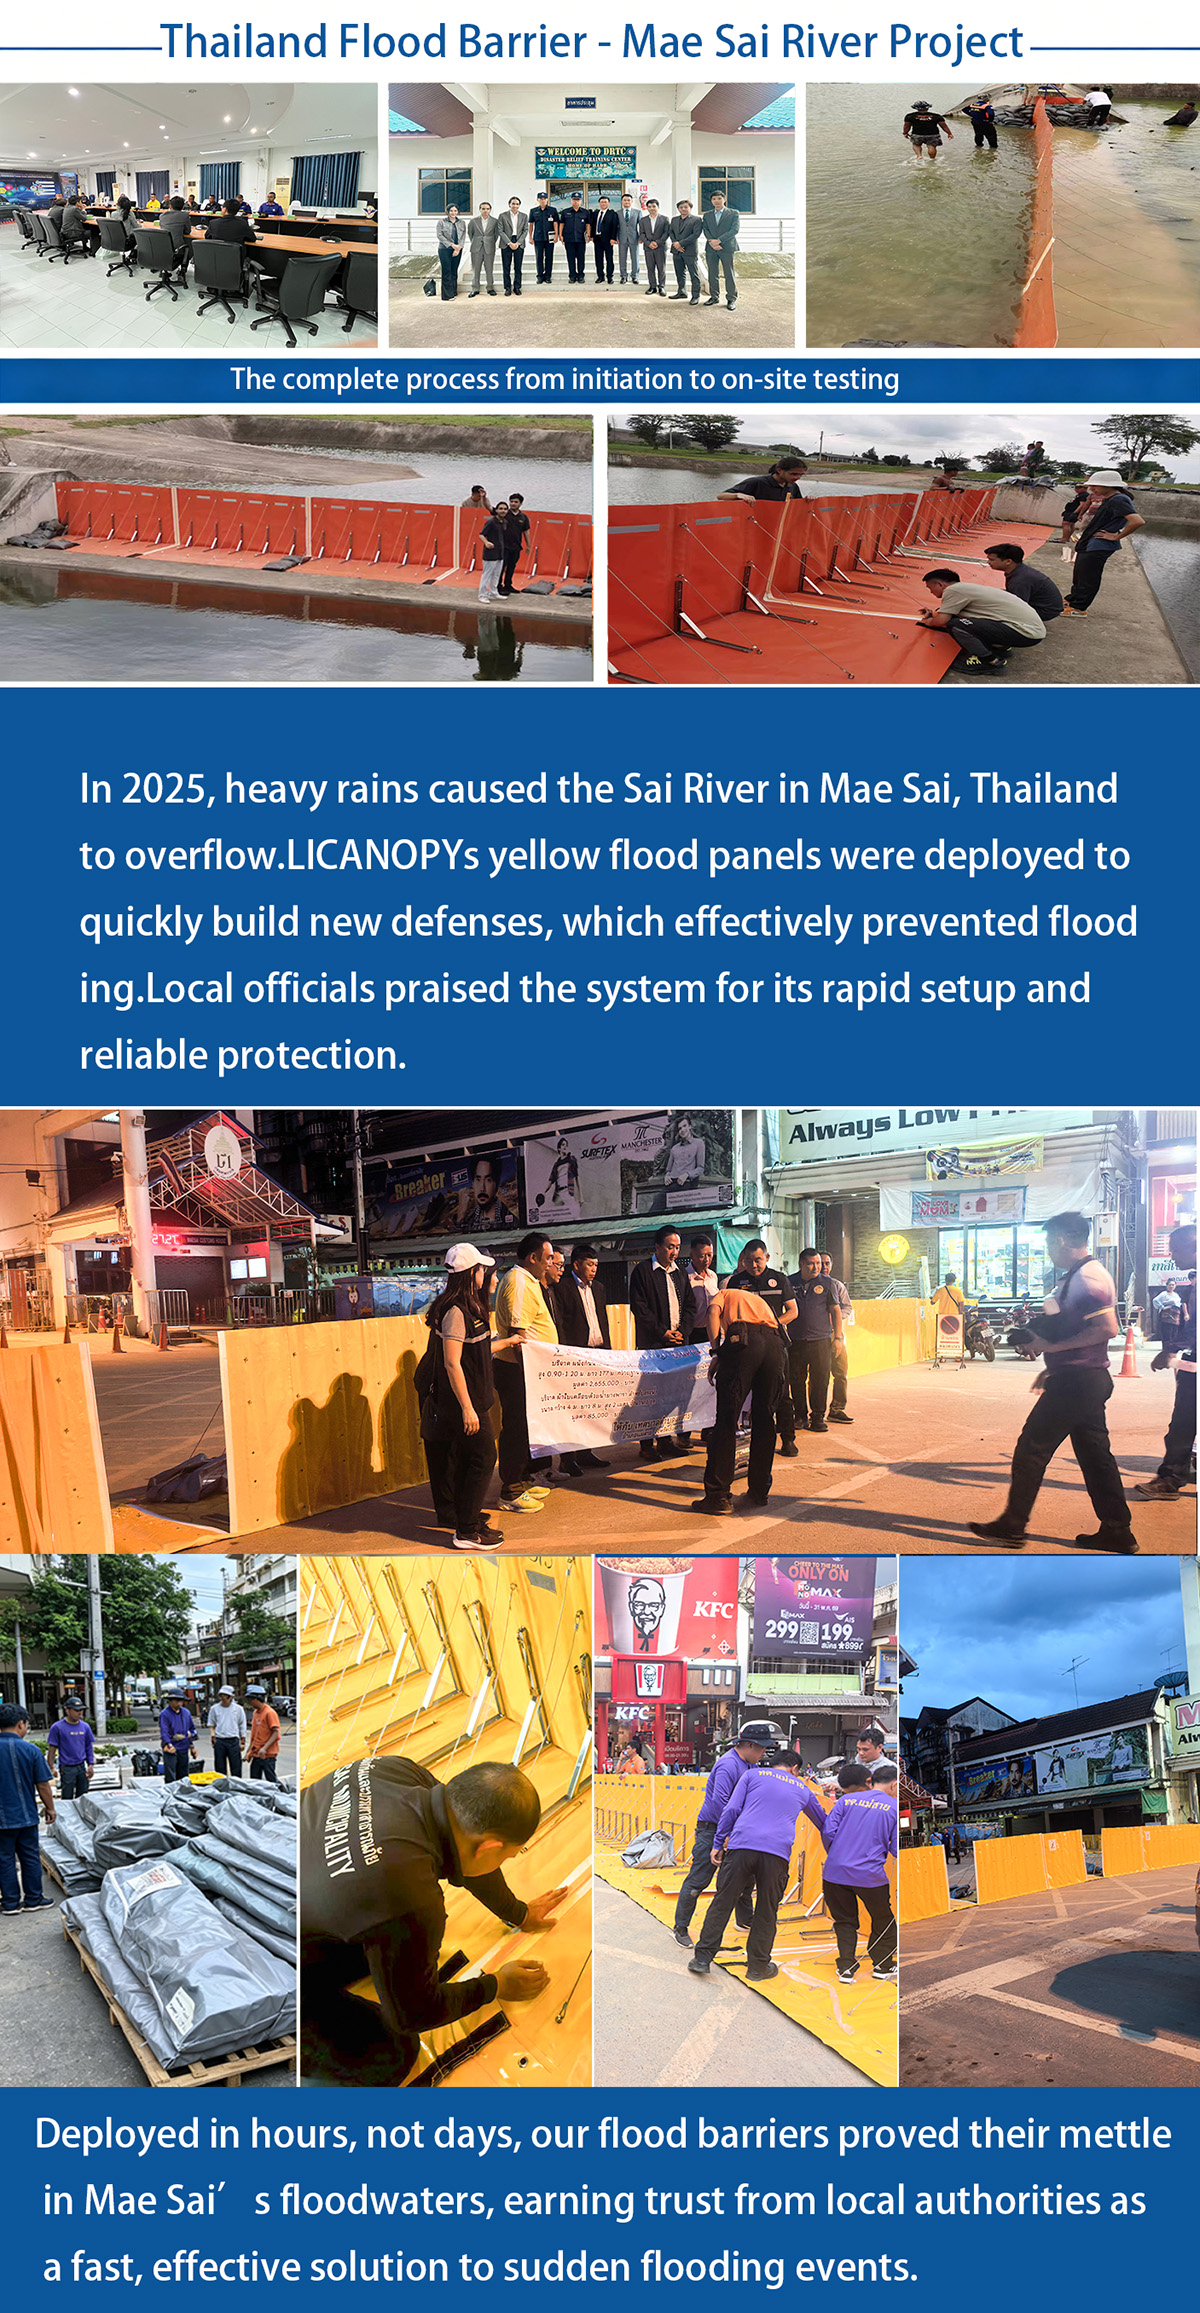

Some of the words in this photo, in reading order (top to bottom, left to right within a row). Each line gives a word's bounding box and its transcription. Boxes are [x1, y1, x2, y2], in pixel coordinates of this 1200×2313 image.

[547, 147, 588, 156] WELCOME
[590, 147, 601, 156] TO
[604, 147, 626, 156] DRTC
[788, 1116, 891, 1144] Always
[621, 1137, 663, 1149] MANCHESTER
[580, 1144, 618, 1160] SURFTEX
[394, 1172, 446, 1200] Breaker
[788, 1565, 826, 1580] ONLY
[828, 1569, 849, 1582] ON
[810, 1587, 842, 1598] MAX
[693, 1601, 734, 1618] KFC
[765, 1619, 799, 1639] 299
[821, 1623, 853, 1640] 199
[614, 1706, 650, 1720] KFC
[968, 1769, 995, 1785] Breaker
[324, 1784, 355, 1878] MUNICIPALITY
